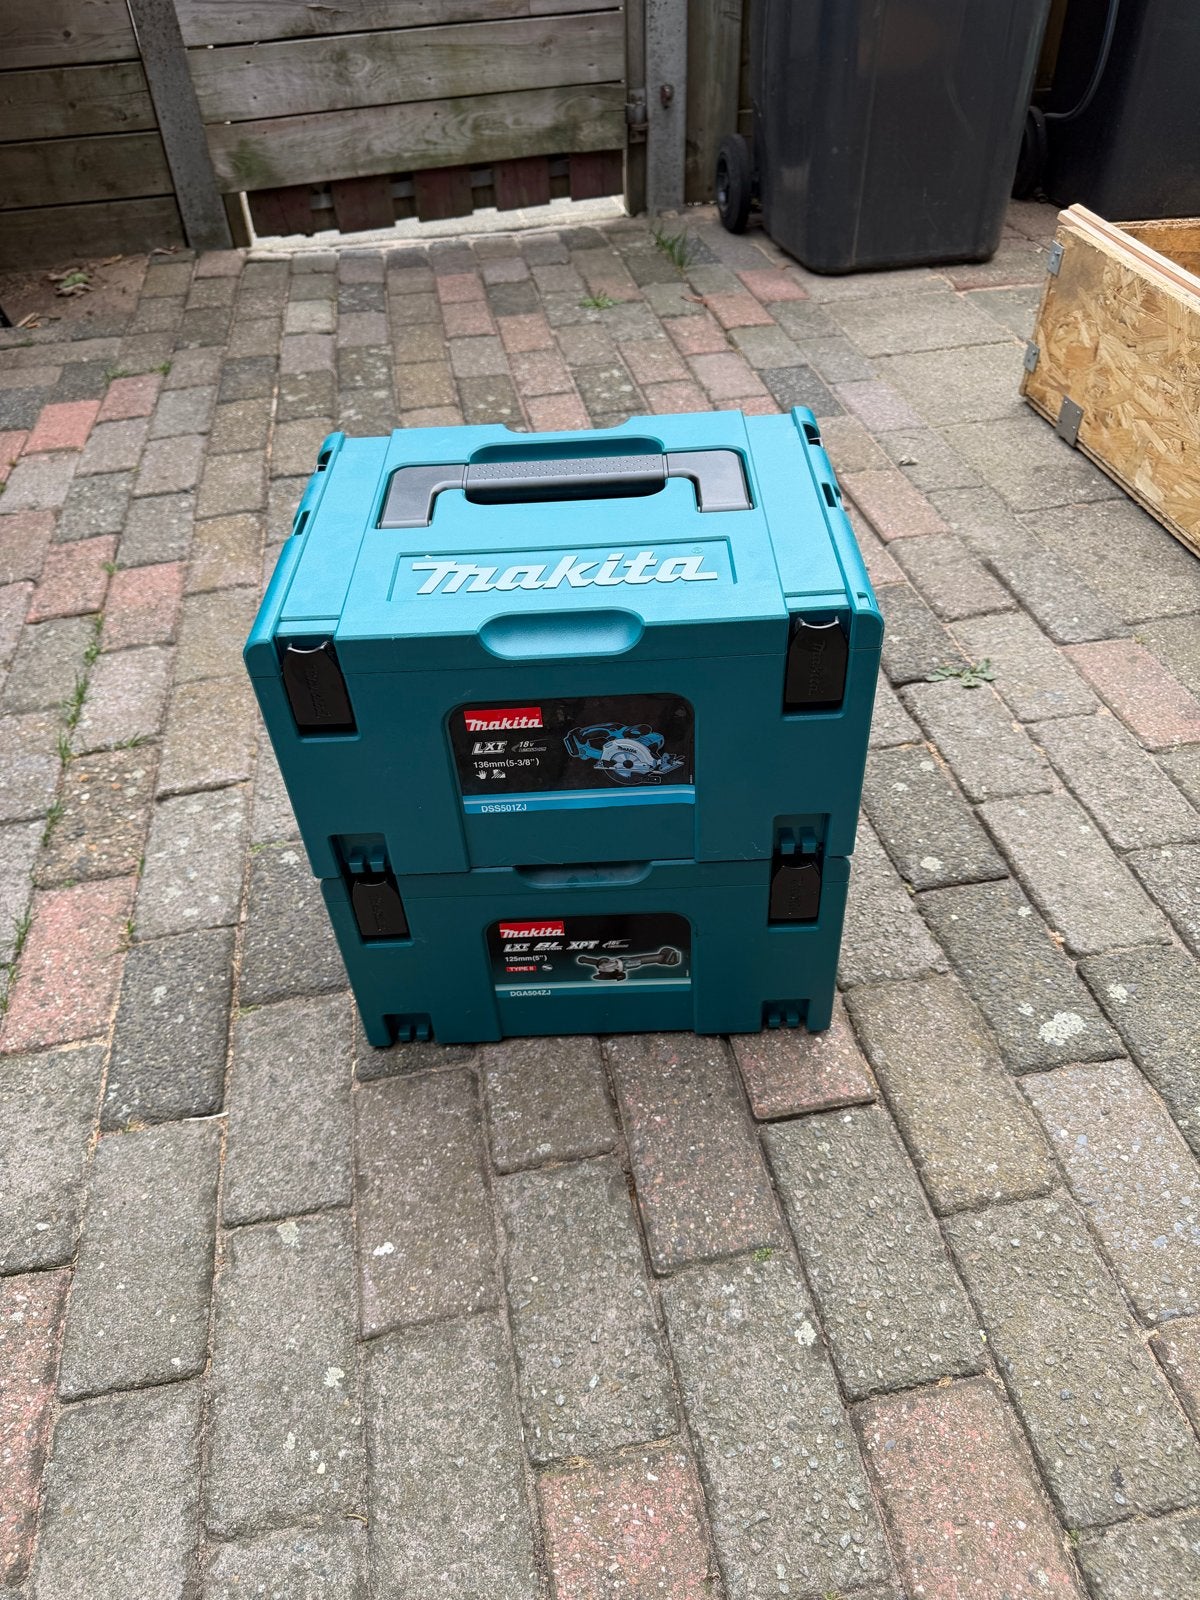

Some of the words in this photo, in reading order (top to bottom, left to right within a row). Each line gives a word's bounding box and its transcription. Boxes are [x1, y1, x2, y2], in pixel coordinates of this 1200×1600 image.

[411, 551, 718, 595] makita
[465, 716, 543, 732] makita
[472, 740, 508, 755] LXT
[481, 803, 527, 813] DSS501ZJ
[500, 928, 565, 938] makita
[503, 943, 531, 952] LXT
[566, 940, 600, 950] XPT
[510, 989, 551, 997] DGA504ZJ
